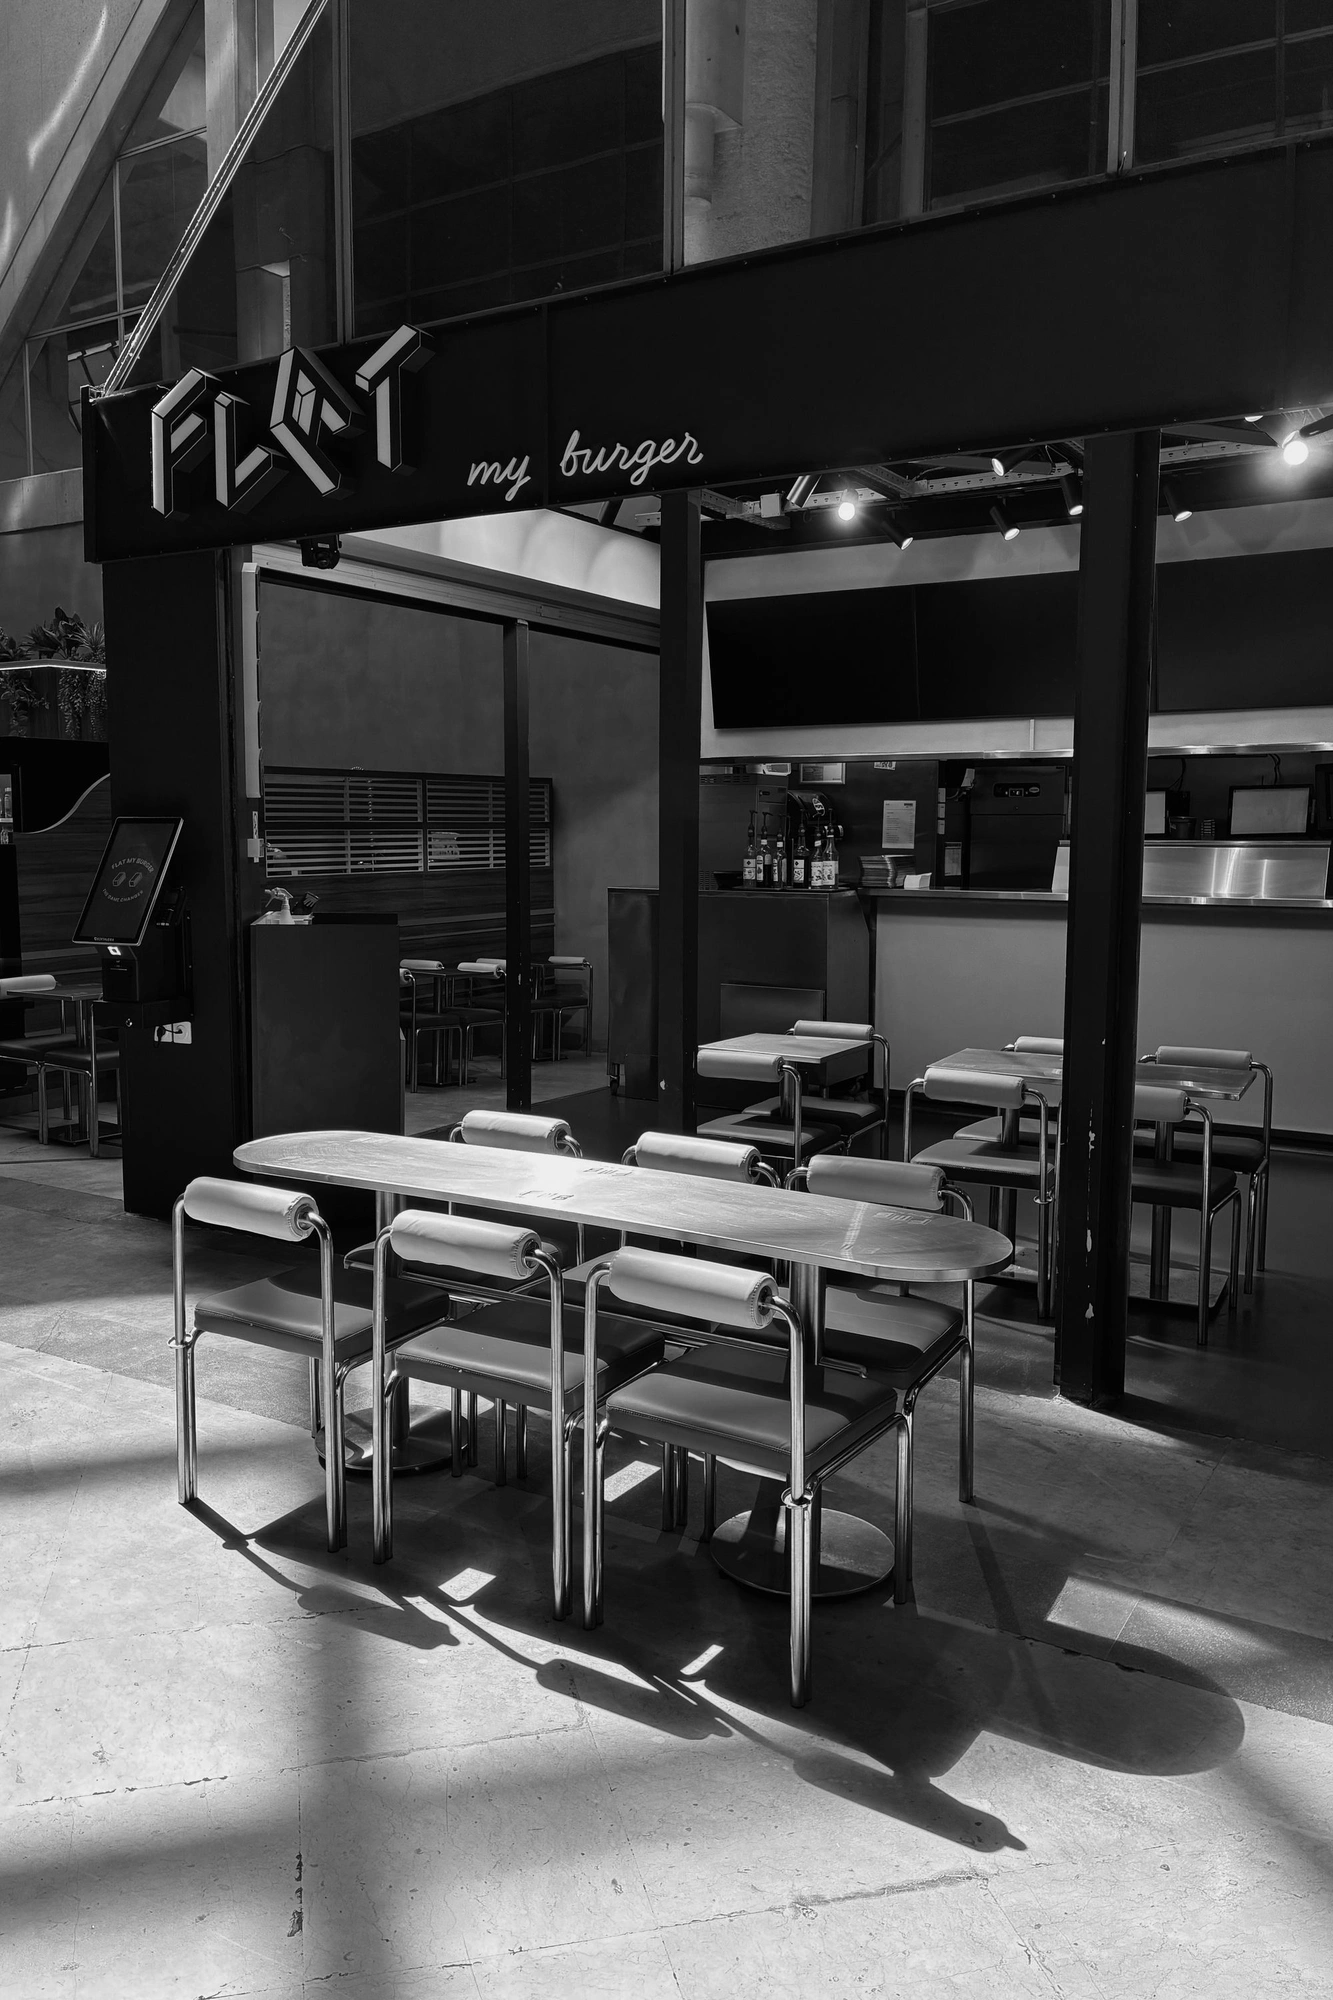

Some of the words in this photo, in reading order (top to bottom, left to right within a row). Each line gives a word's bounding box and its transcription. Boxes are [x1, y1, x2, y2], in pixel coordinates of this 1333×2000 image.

[151, 323, 436, 519] FLAT
[467, 452, 531, 501] my
[561, 430, 704, 487] burger
[111, 858, 126, 870] FLAT
[136, 858, 154, 873] BURGER
